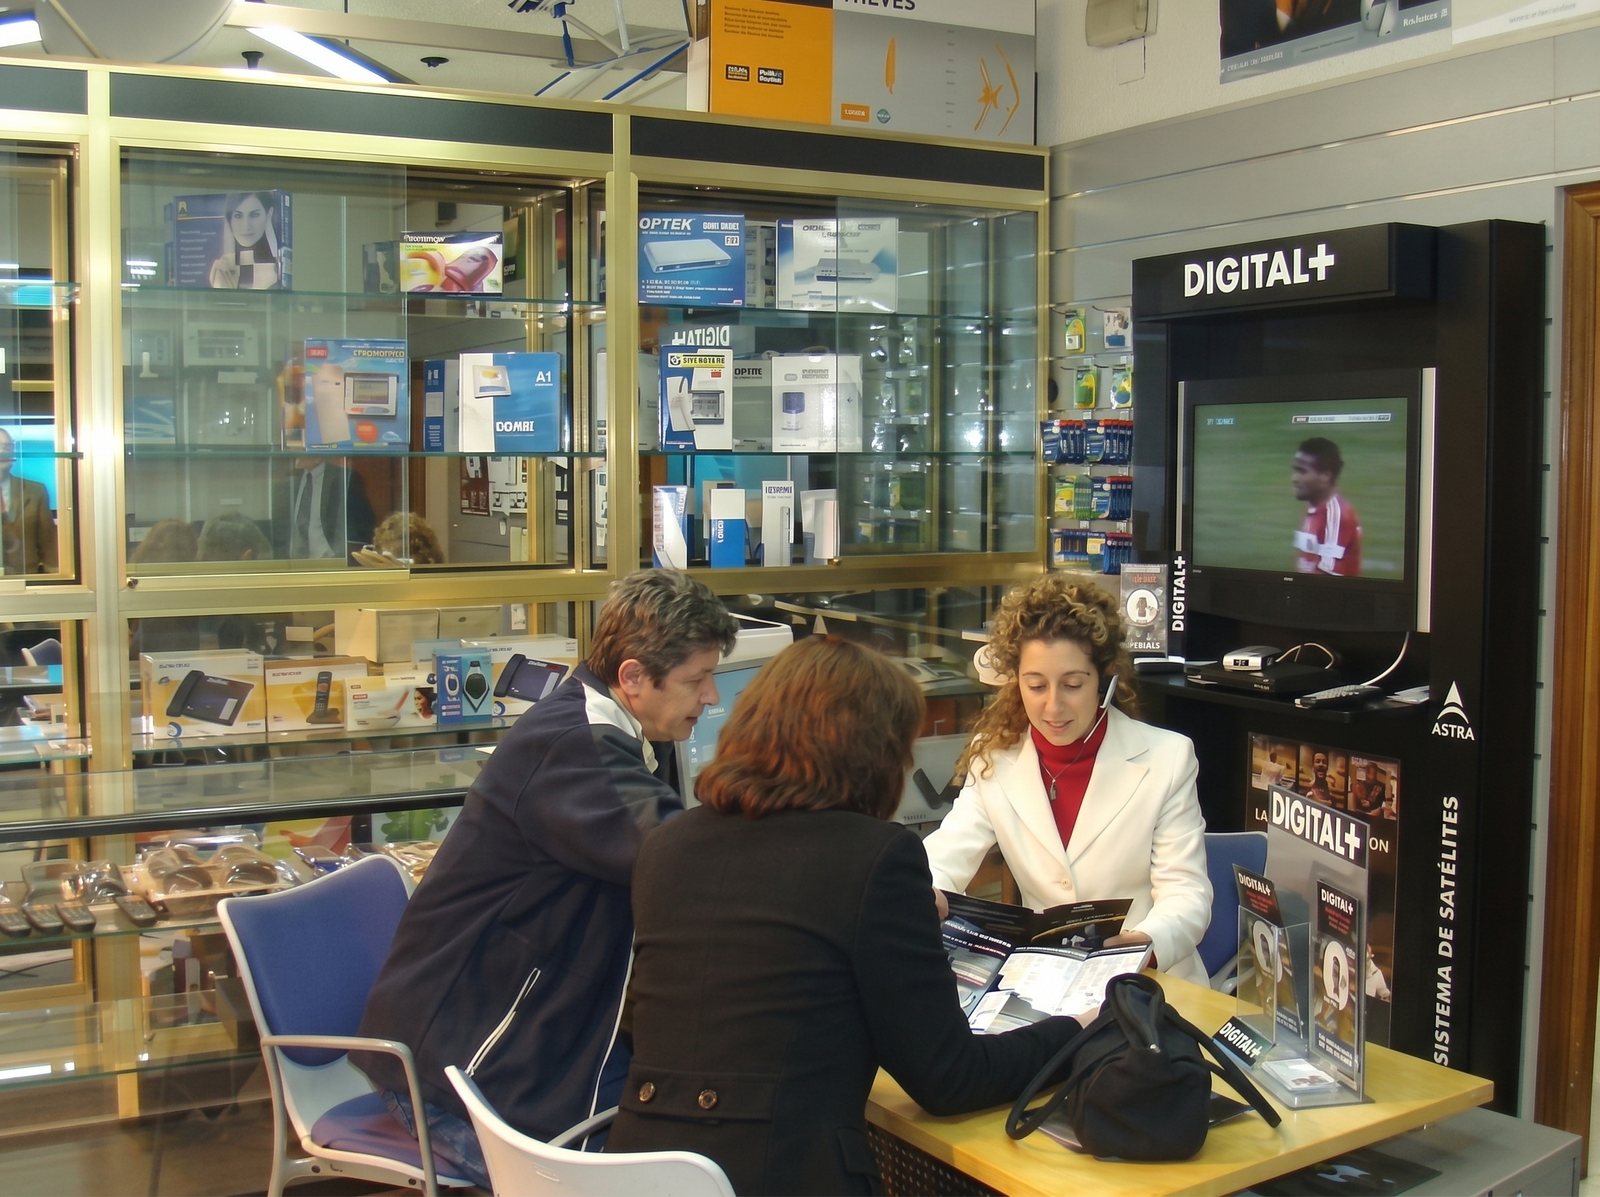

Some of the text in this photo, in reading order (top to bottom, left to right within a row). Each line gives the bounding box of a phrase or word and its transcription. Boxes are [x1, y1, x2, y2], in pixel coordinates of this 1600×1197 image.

[639, 217, 693, 231] OPTEK
[1184, 243, 1335, 298] DIGITAL+
[536, 371, 552, 383] A1
[1171, 555, 1186, 632] DIGITAL+
[1431, 721, 1475, 741] ASTRA
[1272, 790, 1361, 861] DIGITAL+
[1238, 872, 1272, 897] DIGITAL+
[1320, 887, 1354, 916] DIGITAL+
[1433, 796, 1459, 1067] SISTEMA DE SATÉLITES
[1218, 1021, 1263, 1059] DIGITAL+
